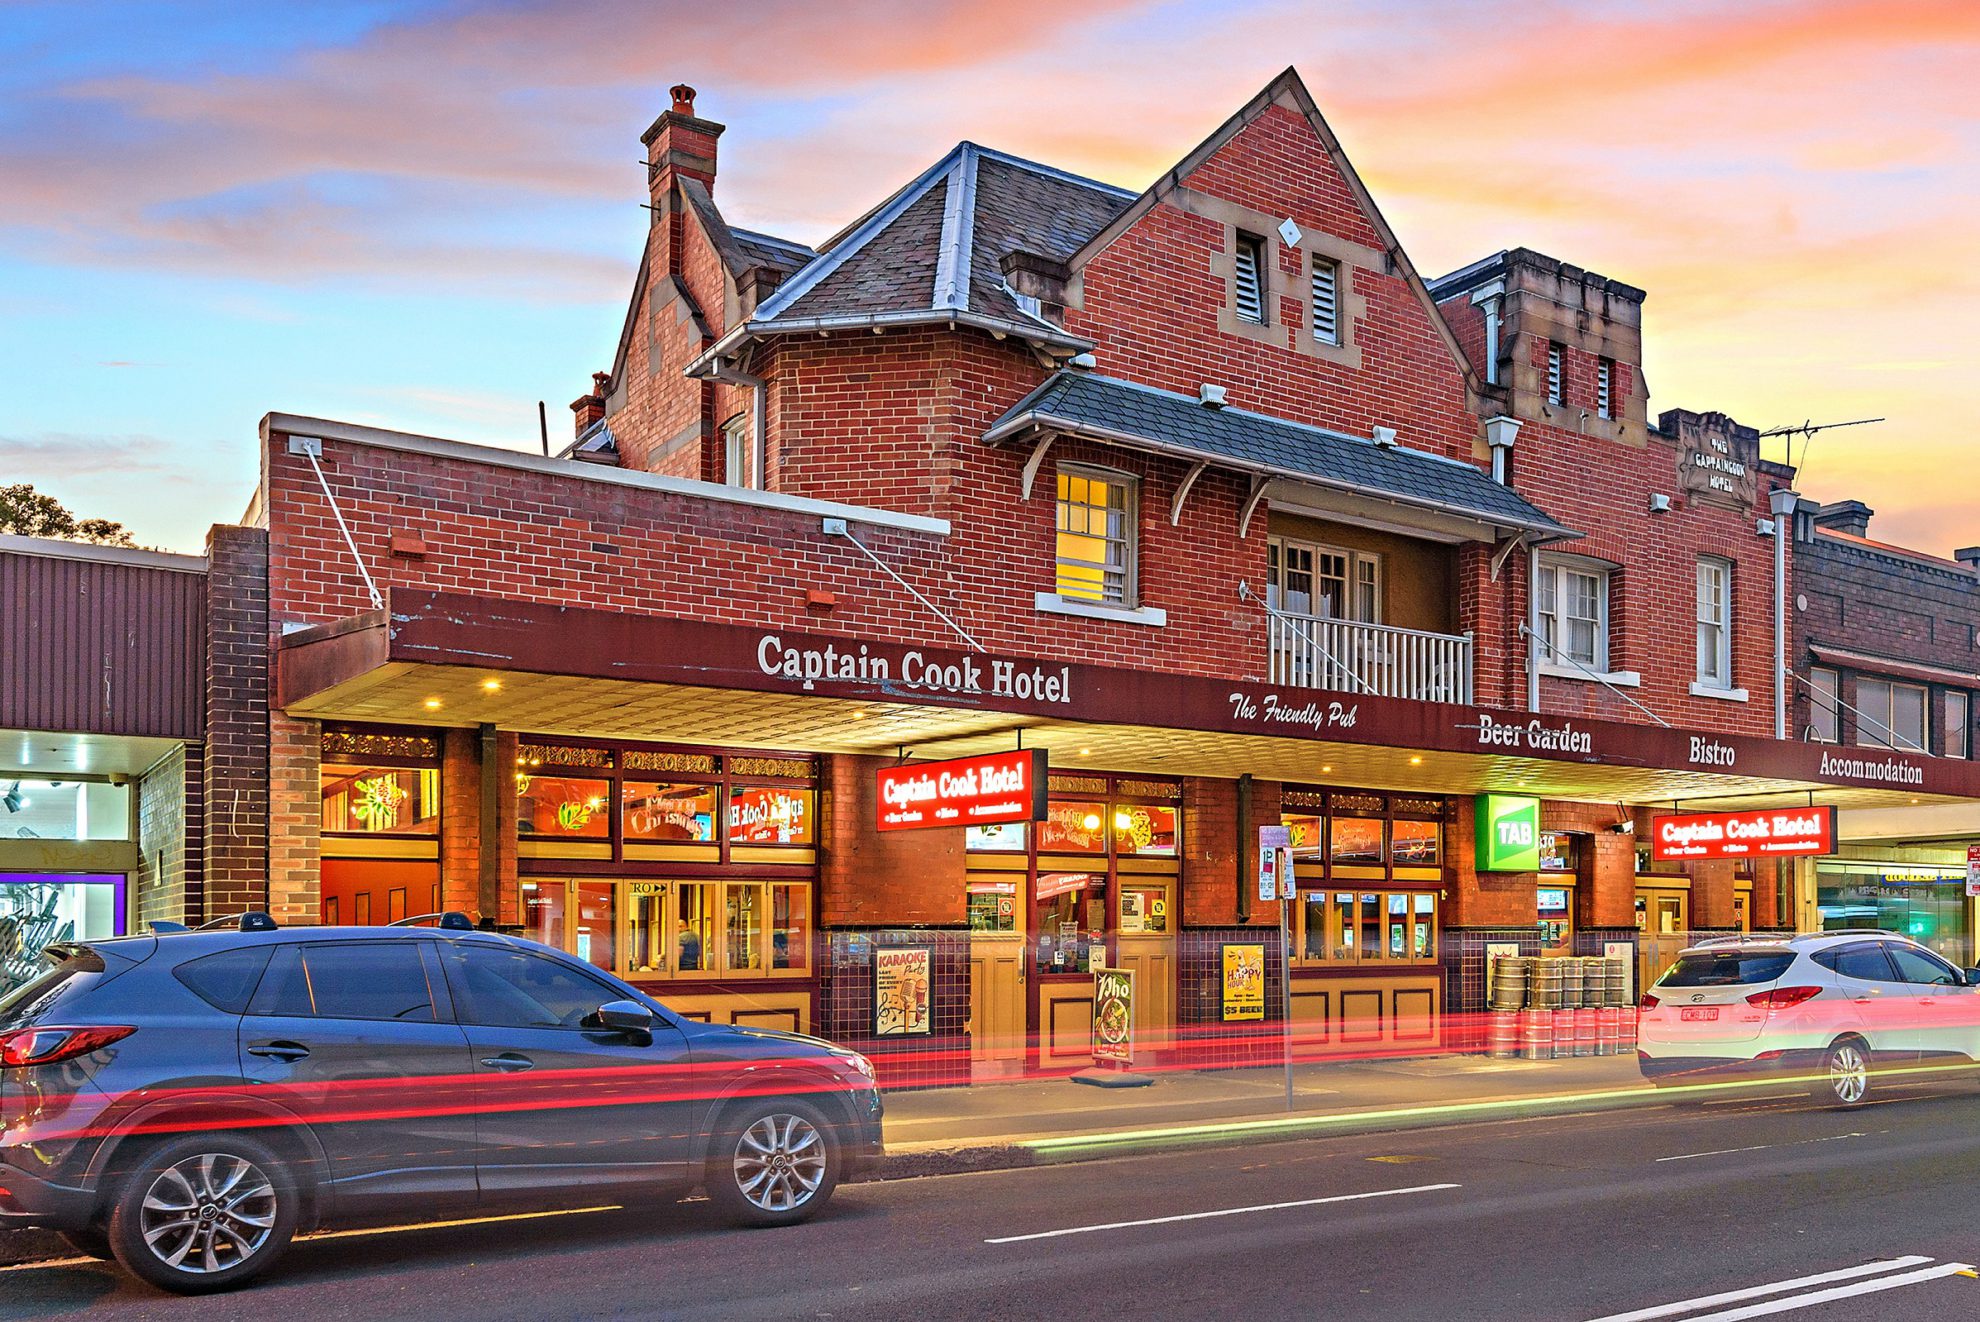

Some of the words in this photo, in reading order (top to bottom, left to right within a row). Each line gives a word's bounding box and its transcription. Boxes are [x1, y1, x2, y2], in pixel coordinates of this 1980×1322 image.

[1711, 438, 1728, 454] THE
[1709, 474, 1733, 493] HOTEL
[757, 635, 890, 690] Captain
[901, 651, 983, 695] Cook
[991, 660, 1072, 703] Hotel
[1229, 693, 1258, 720] The
[1263, 694, 1323, 731] Friendly
[1328, 701, 1357, 728] Pub
[1478, 714, 1522, 747] Beer
[1528, 719, 1592, 754] Garden
[1689, 736, 1736, 767] Bistro
[1819, 751, 1923, 785] Accommodation
[884, 774, 937, 809] Captain
[939, 768, 978, 798] Cook
[980, 762, 1024, 794] Hotel
[645, 795, 697, 818] Merry
[1497, 822, 1532, 845] TAB
[1662, 820, 1724, 846] Captain
[1726, 817, 1770, 839] Cook
[1772, 814, 1821, 836] Hotel
[879, 951, 927, 969] KARAOKE
[904, 962, 926, 976] Party
[1097, 972, 1130, 1002] Pho
[1227, 968, 1262, 983] HAPPY
[1227, 980, 1245, 990] HOUR
[1225, 1006, 1238, 1015] $5
